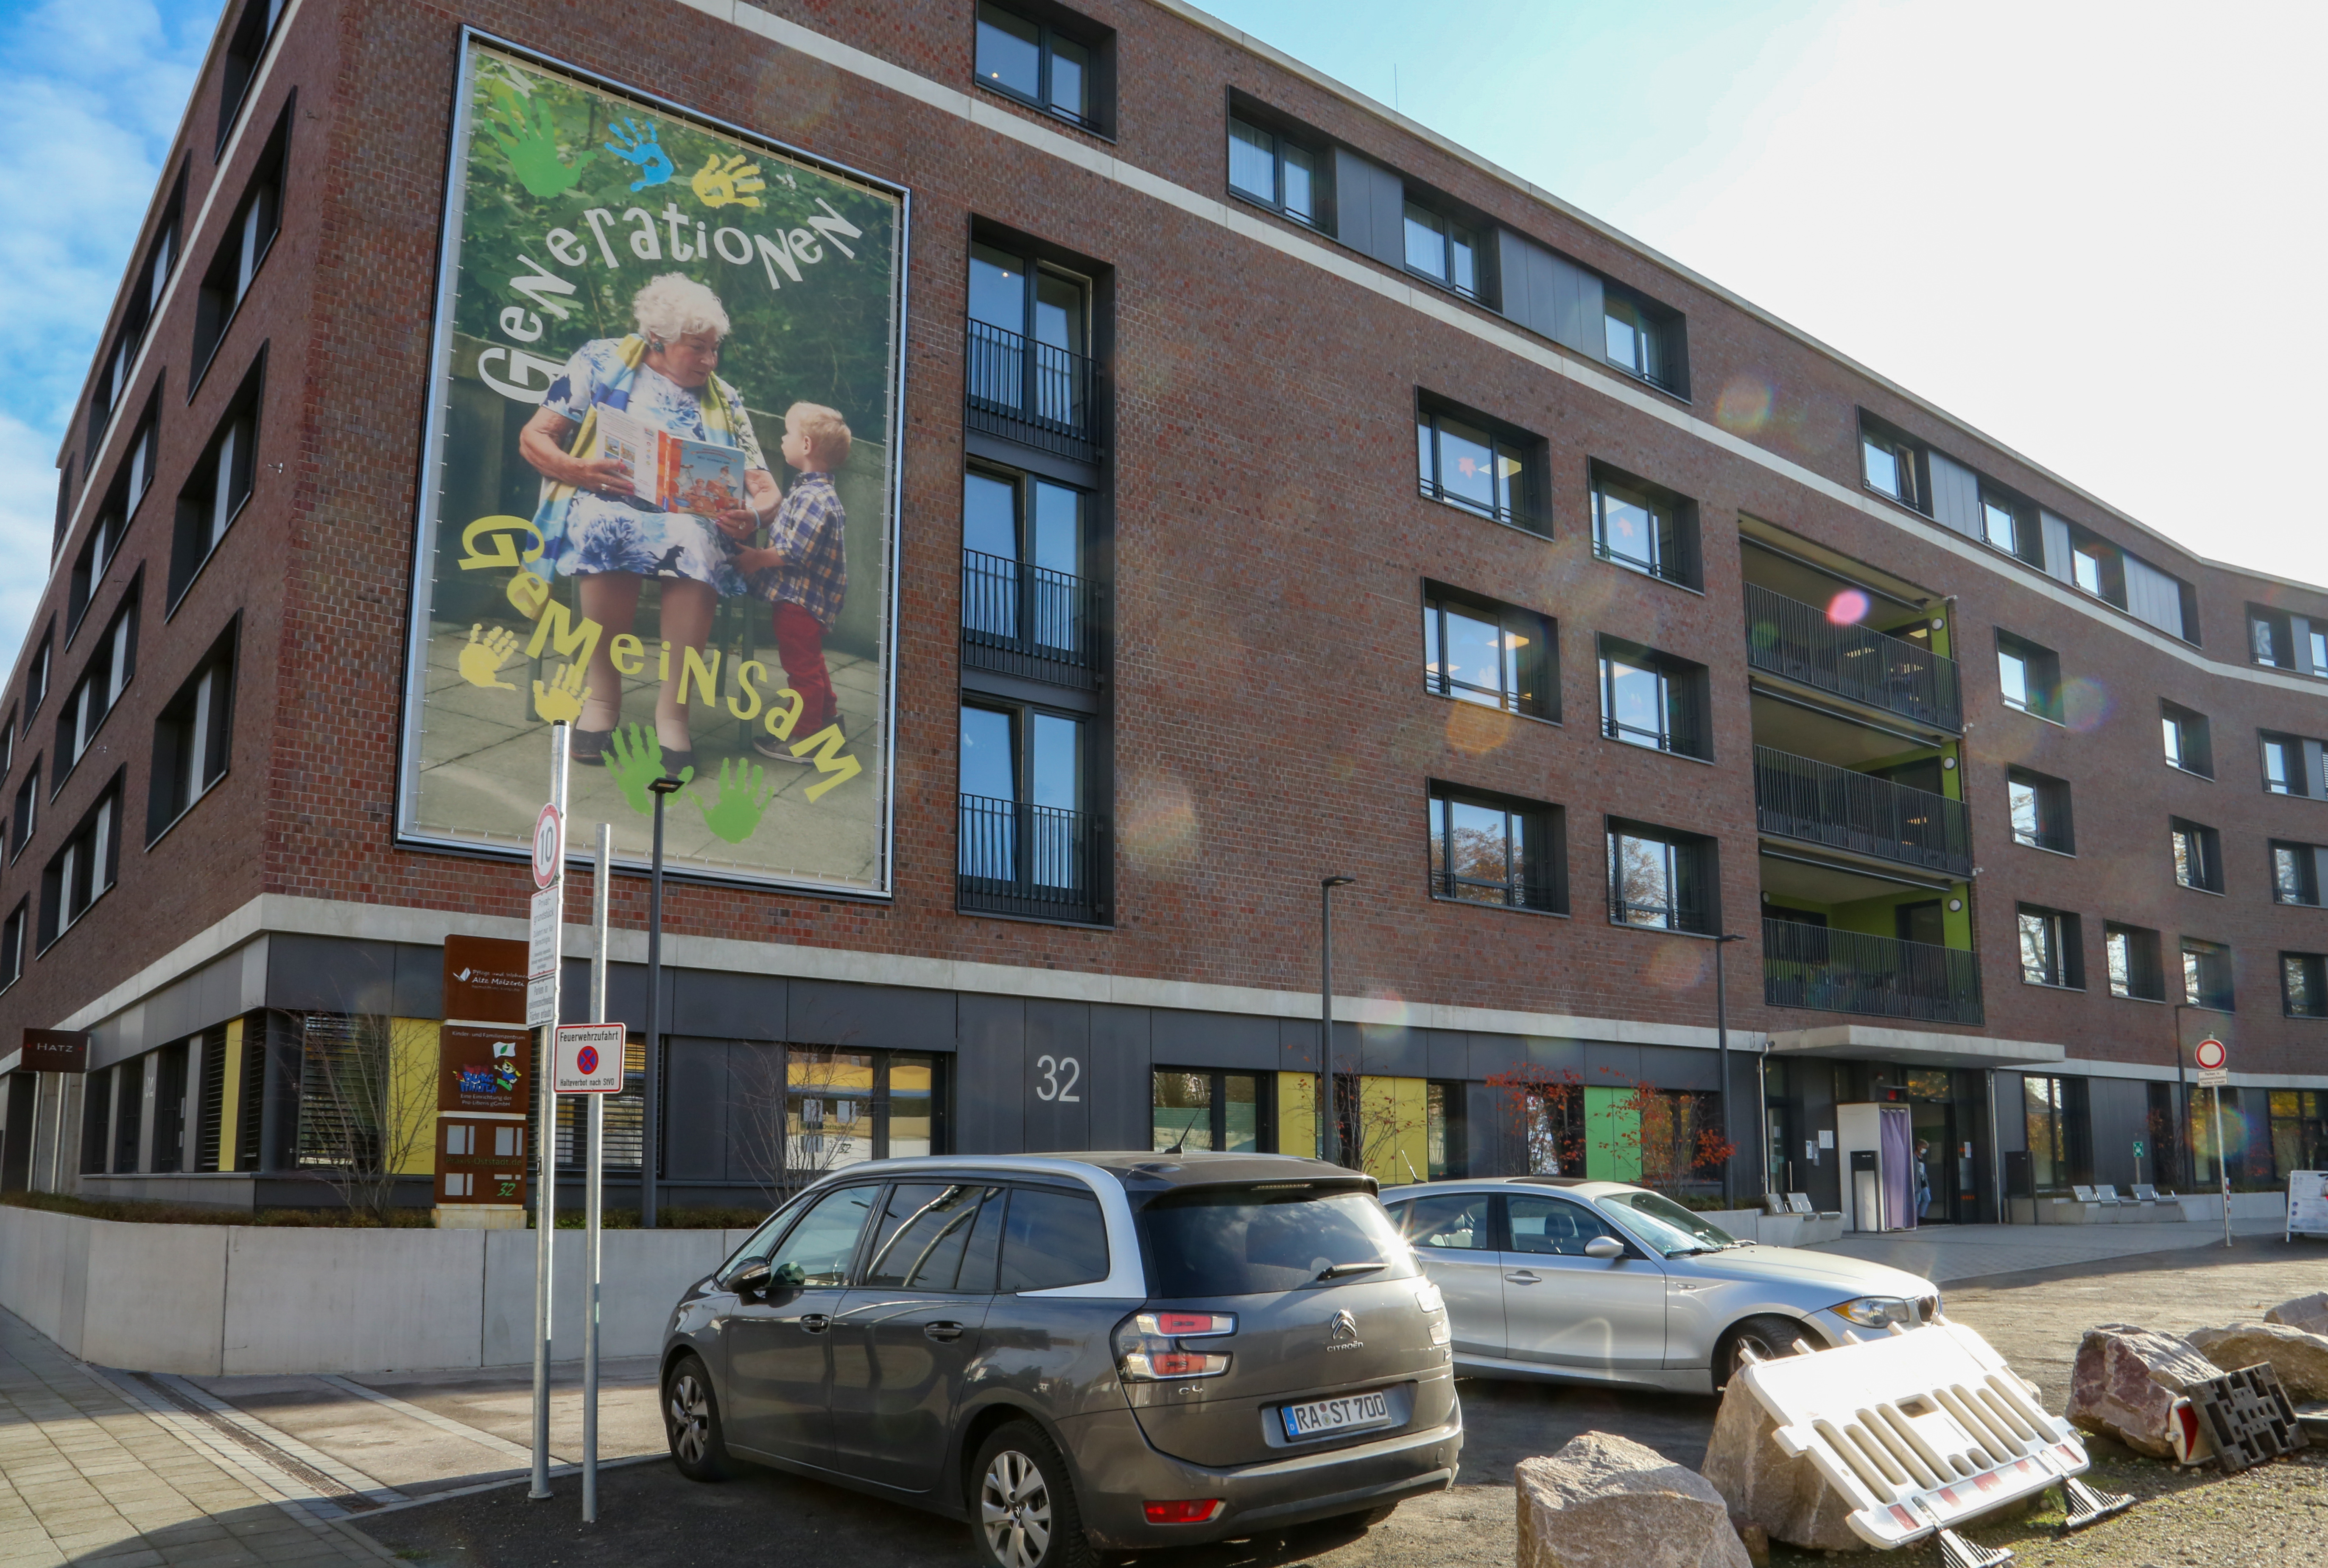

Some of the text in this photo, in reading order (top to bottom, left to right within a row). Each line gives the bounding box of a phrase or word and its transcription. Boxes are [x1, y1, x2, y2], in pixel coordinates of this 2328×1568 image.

[540, 826, 553, 865] 10
[491, 978, 525, 986] Mälzerei
[534, 986, 544, 995] Parken
[560, 1031, 618, 1042] Feuerwehrzufahrt
[37, 1043, 73, 1052] HATZ
[603, 1078, 615, 1086] StVO
[1036, 1055, 1080, 1102] 32
[446, 1157, 522, 1166] Praxis-Oststadt.de
[497, 1182, 516, 1197] 32
[1178, 1384, 1204, 1395] C4
[1295, 1395, 1386, 1430] RA ST 700
